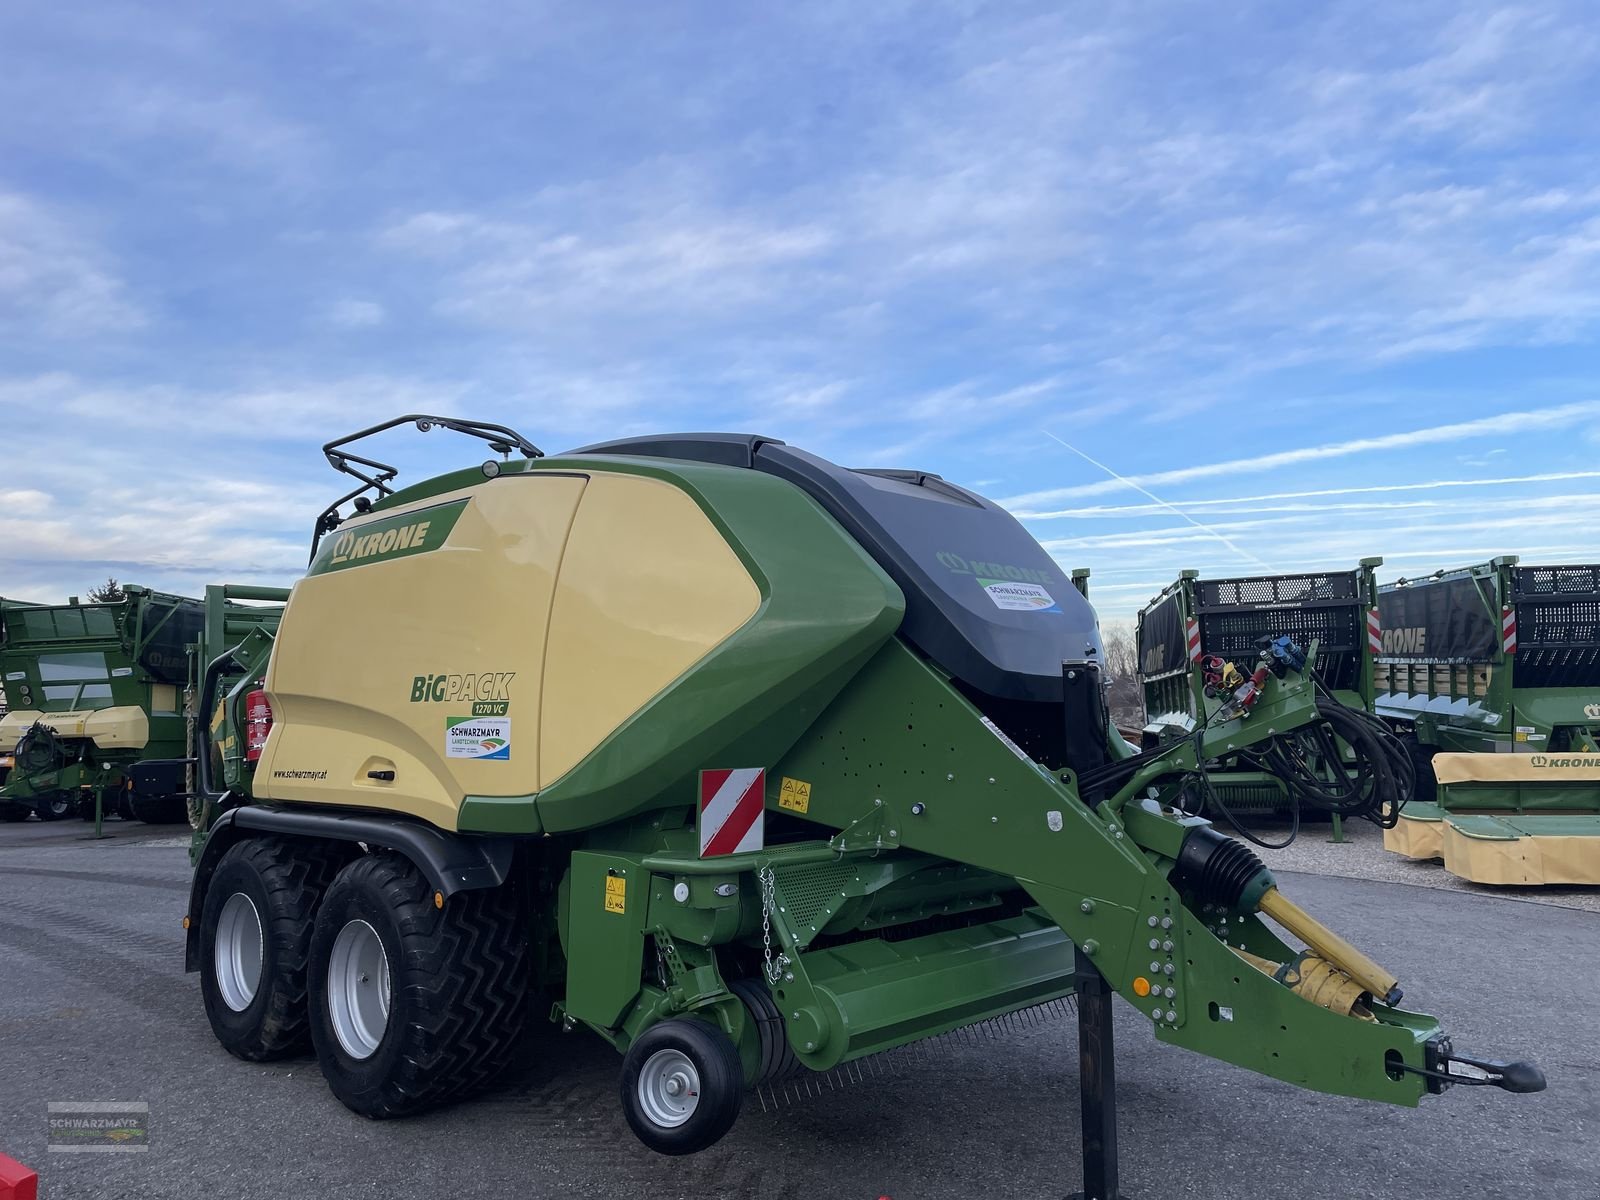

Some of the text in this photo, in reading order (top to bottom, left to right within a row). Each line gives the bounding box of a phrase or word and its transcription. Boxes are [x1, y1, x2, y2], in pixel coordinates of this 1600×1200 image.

[349, 521, 431, 560] KRONE
[969, 560, 1055, 585] KRONE
[988, 586, 1042, 597] SCHWARZMAYR
[475, 704, 505, 714] 1270 VC
[451, 727, 500, 737] SCHWARZMAYR
[273, 769, 328, 781] www.schwarzmayr.at
